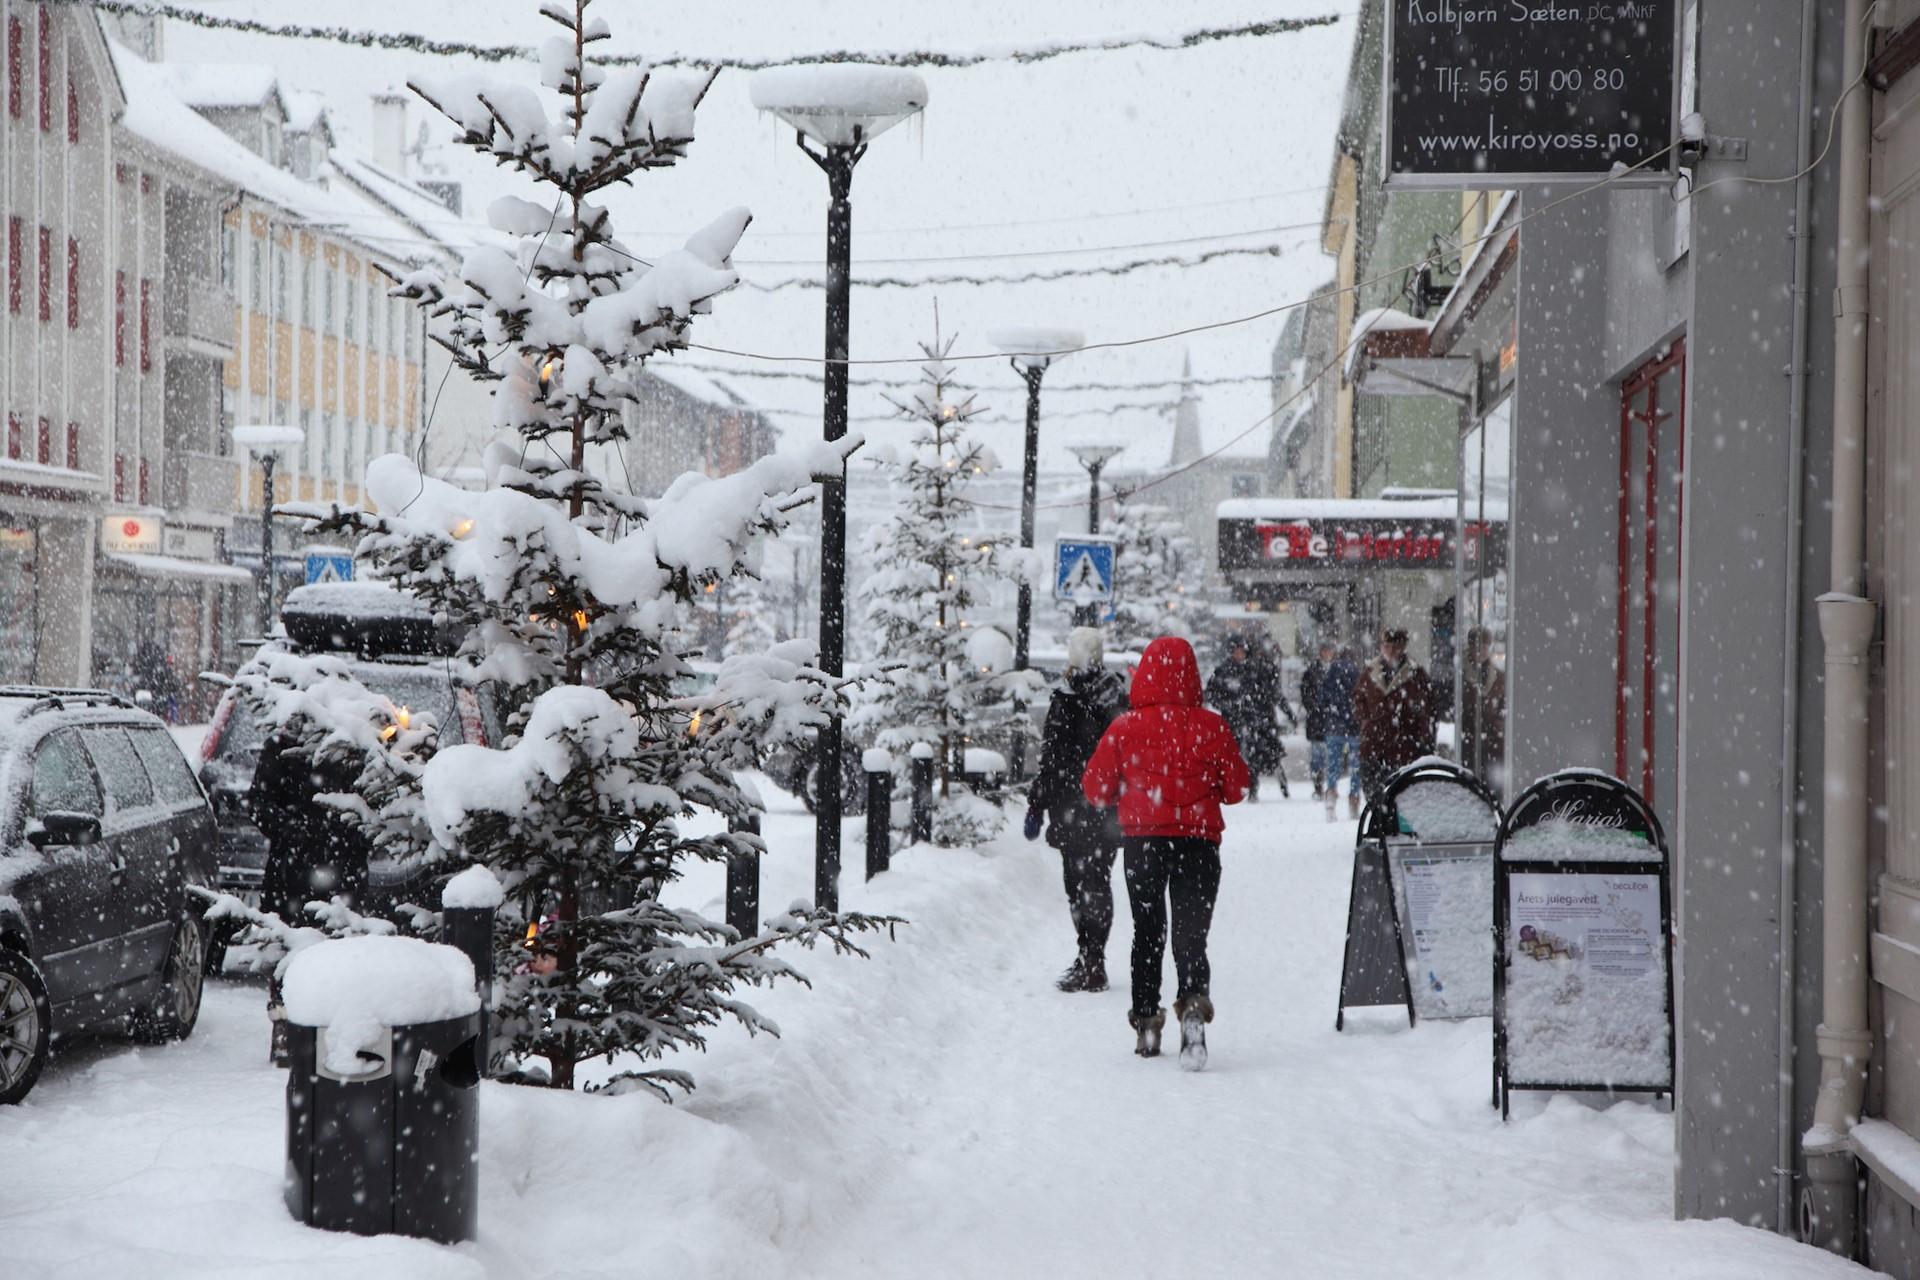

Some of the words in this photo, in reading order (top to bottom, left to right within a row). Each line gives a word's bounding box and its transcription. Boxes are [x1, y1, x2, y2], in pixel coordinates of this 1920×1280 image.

[1408, 0, 1497, 34] Kolbjørn
[1479, 70, 1508, 93] 56
[1519, 70, 1540, 92] 51
[1550, 69, 1582, 91] 00
[1594, 68, 1624, 91] 80
[1419, 114, 1639, 150] www.kirovoss.no
